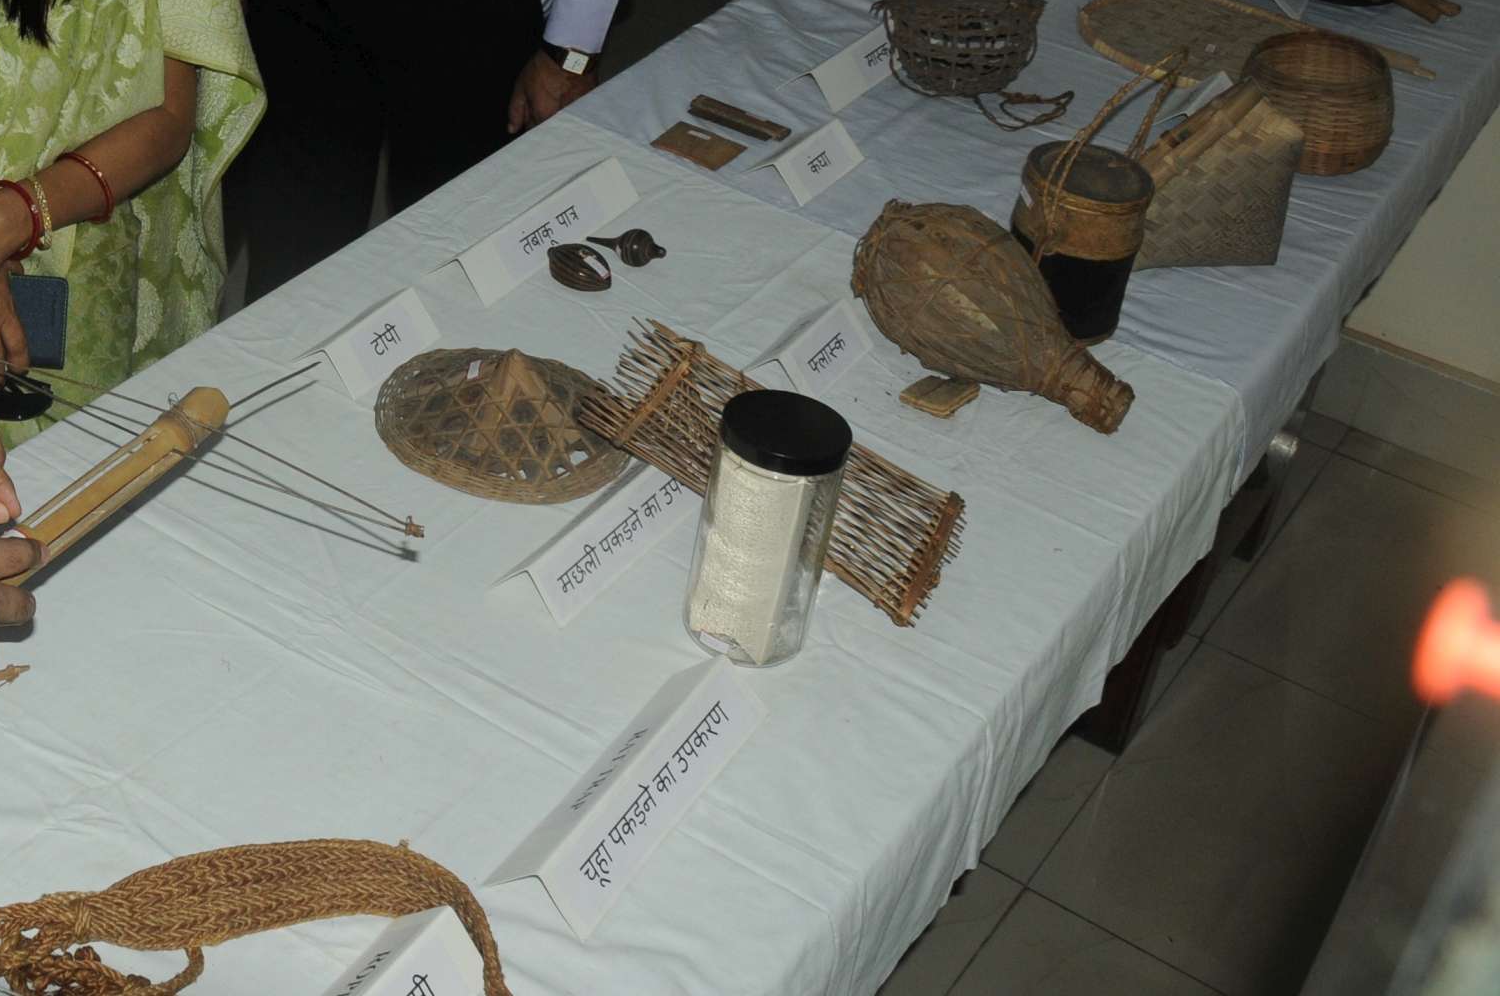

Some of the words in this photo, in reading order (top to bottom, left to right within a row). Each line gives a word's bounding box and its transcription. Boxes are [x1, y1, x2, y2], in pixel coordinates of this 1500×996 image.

[807, 150, 831, 174] कंघा
[555, 205, 581, 229] पात्र
[369, 323, 402, 356] टोपी
[807, 332, 846, 373] फ्लास्क
[556, 544, 602, 594] मछली
[598, 507, 644, 555] पकड़ने
[640, 494, 662, 520] का
[659, 477, 683, 505] उप
[579, 839, 613, 889] चूहा
[608, 784, 657, 846] पकड़ने
[652, 762, 677, 795] का
[672, 700, 730, 774] उपकरण
[335, 950, 391, 996] ROP
